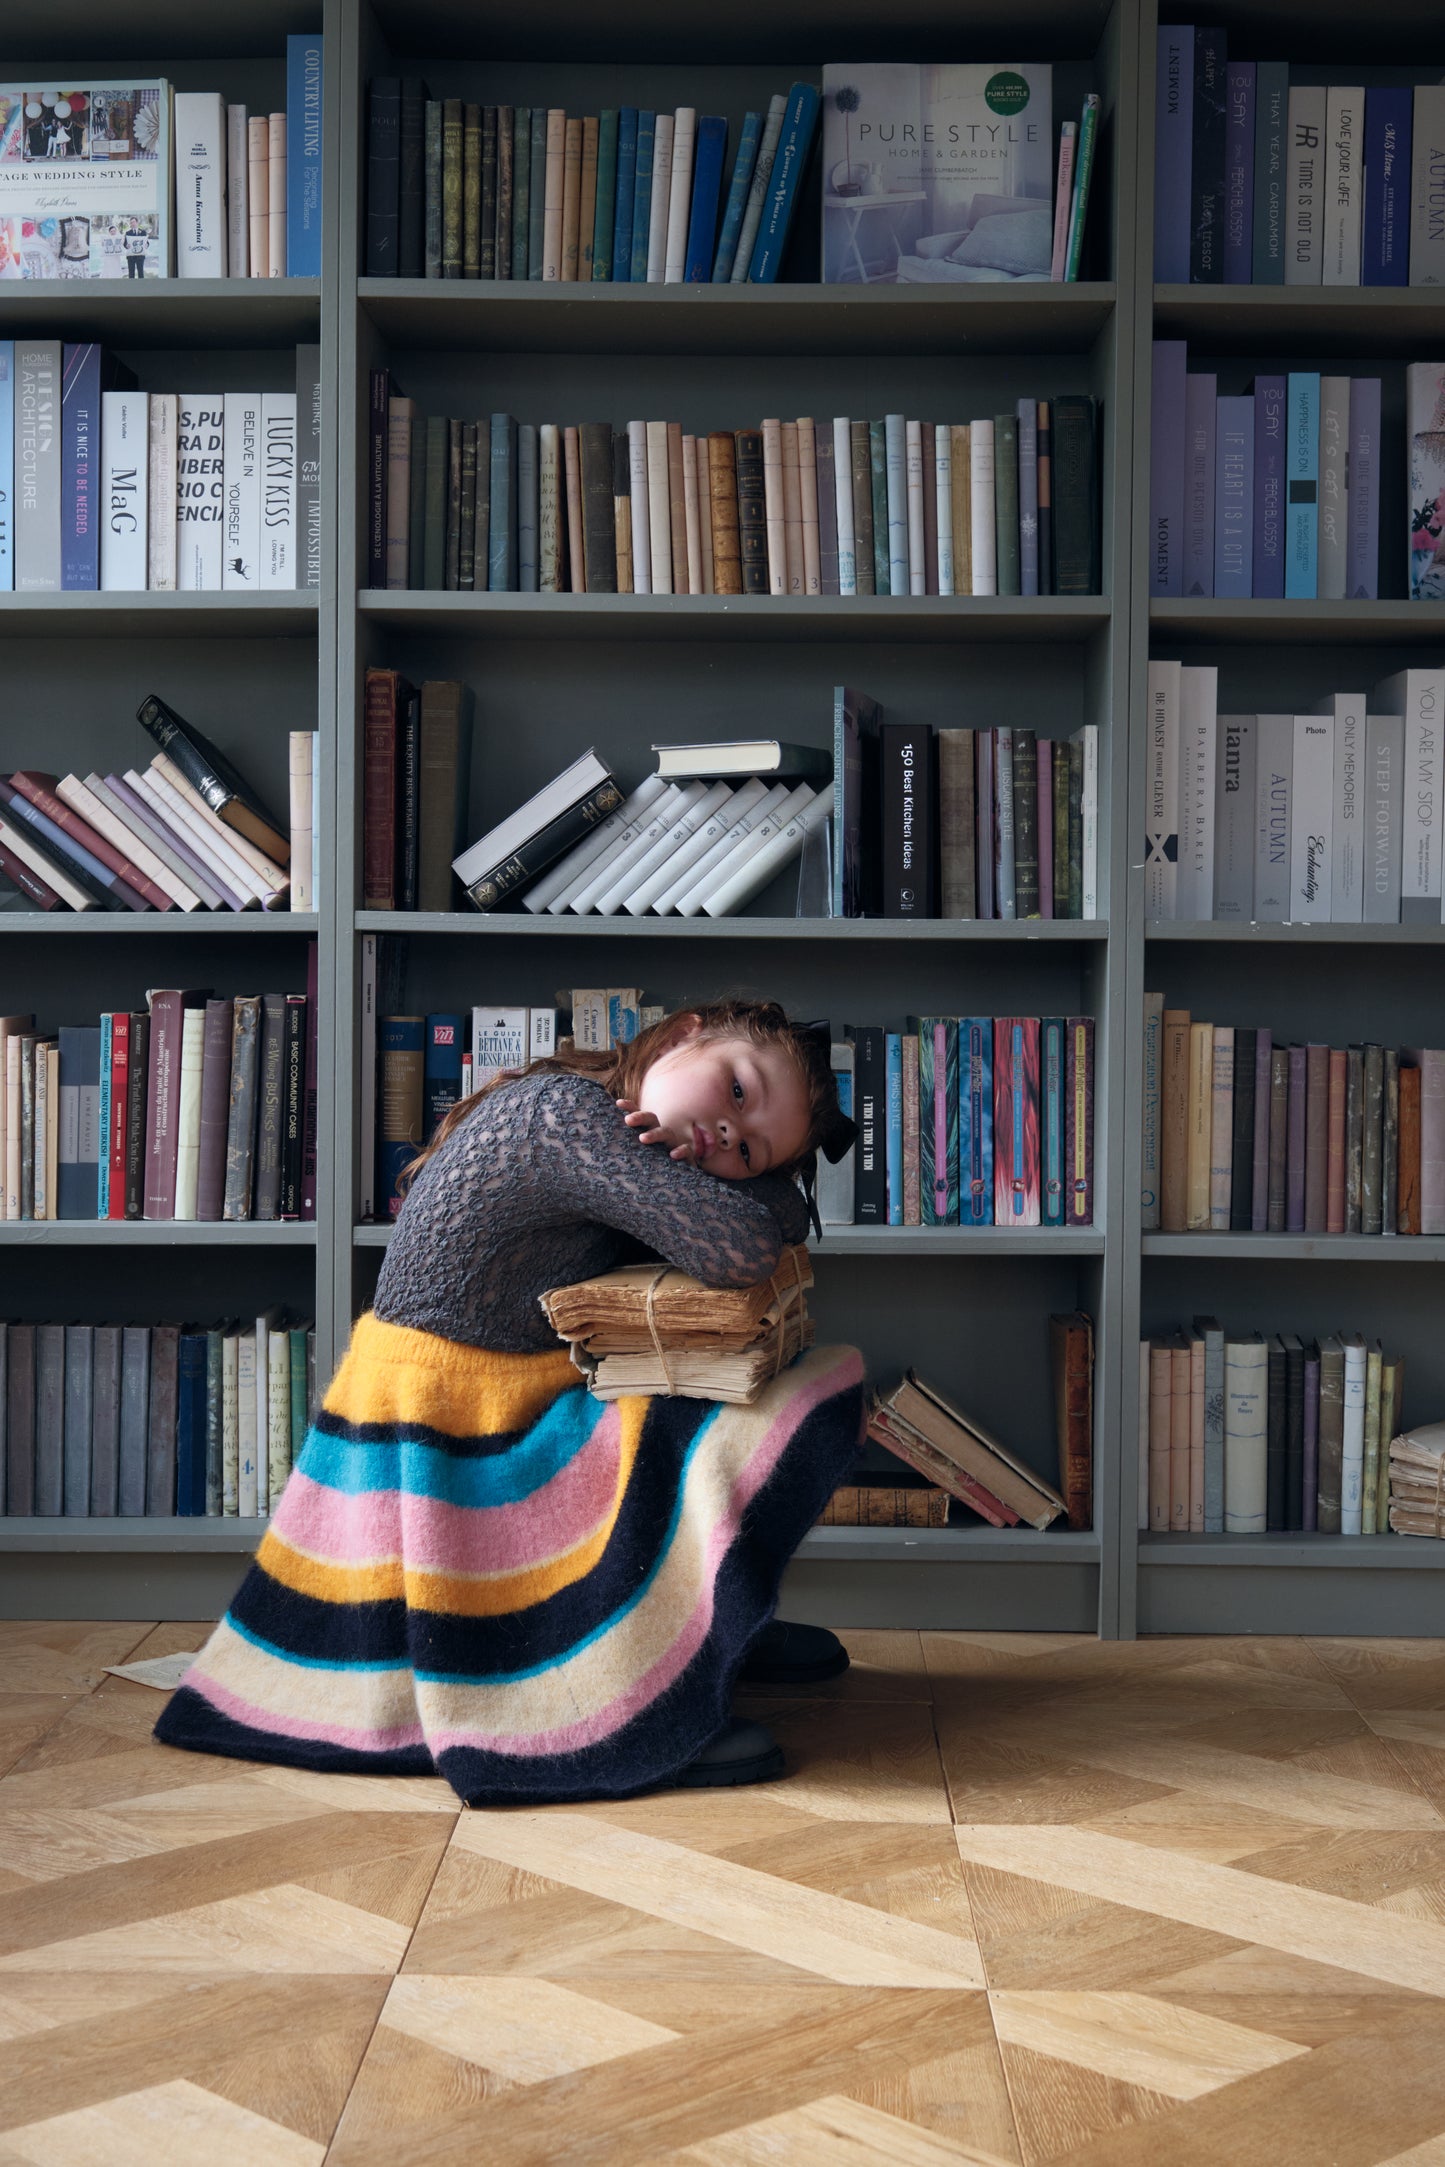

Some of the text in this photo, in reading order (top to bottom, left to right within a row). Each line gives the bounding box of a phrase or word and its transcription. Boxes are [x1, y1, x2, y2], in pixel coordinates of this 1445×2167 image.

[1168, 45, 1180, 115] MOMENT
[1204, 48, 1216, 89] HAPPY
[1231, 77, 1251, 87] YOU
[303, 49, 320, 157] COUNTRY LIVING
[1232, 92, 1247, 127] SAY
[1340, 109, 1352, 139] LOVE
[860, 124, 1038, 143] PURE STYLE
[889, 149, 1008, 158] HOME GARDEN
[33, 169, 143, 180] WEDDING STYLE
[303, 166, 311, 230] For The Seasons
[772, 145, 796, 217] GROWTH WORLD
[1269, 91, 1281, 258] THAT CARDAMOM
[1429, 148, 1445, 241] AUTUMN
[195, 174, 203, 242] Anna Karenina
[232, 177, 242, 234] Wine Tasting
[1296, 160, 1314, 263] TIME IS NOT OLD
[1201, 229, 1212, 270] tresor
[22, 353, 52, 363] HOME
[38, 372, 52, 452] DESIGN
[1263, 389, 1285, 400] YOU
[22, 371, 36, 509] ARCHITECTURE
[243, 410, 255, 477] BELIEVE IN
[1265, 404, 1279, 439] SAY
[1297, 392, 1309, 472] HAPPINESS IS ON
[75, 410, 88, 537] IT IS NICE TO BE NEEDED.
[264, 417, 294, 527] LUCKY KISS
[374, 434, 384, 559] DE L'ŒNOLOGIE LA VITICULTURE
[1323, 408, 1340, 546] LET'S GET LOST
[111, 467, 138, 535] MaG
[1222, 432, 1245, 574] IF HEART IS A CITY
[1356, 487, 1369, 526] PERSON
[307, 500, 320, 586] IMPOSSIBLE
[1157, 516, 1169, 585] MOMENT
[1263, 509, 1278, 556] BLOSSOM
[777, 576, 783, 589] 1
[792, 577, 800, 589] 2
[810, 576, 818, 589] 3
[404, 724, 414, 742] THE
[1154, 692, 1165, 778] BE HONEST RATHER
[1305, 726, 1326, 734] Photo
[1343, 715, 1355, 750] ONLY
[404, 743, 414, 775] EQUITY
[833, 703, 842, 819] FRENCH COUNTRY LIVING
[1225, 726, 1248, 793] ianra
[1417, 686, 1435, 827] YOU ARE MY STOP
[404, 777, 414, 795] RISK
[901, 743, 914, 870] 150 Best Kitchen Ideas
[1002, 767, 1012, 841] TUSCANY STYLE
[1194, 727, 1207, 872] BARBERA BAREY
[1342, 752, 1355, 819] MEMORIES
[404, 798, 414, 839] PREMIUM
[622, 832, 632, 841] 3
[706, 827, 716, 836] 6
[760, 827, 770, 836] 8
[786, 828, 796, 838] 9
[1270, 773, 1288, 864] AUTUMN
[1375, 746, 1391, 894] STEP FORWARD
[478, 1037, 521, 1052] BETTANE &
[591, 1009, 599, 1044] Cases and
[288, 1010, 299, 1139] RUDDEN BASIC COMMUNITY CASES
[478, 1052, 522, 1067] DESSEAUVE
[972, 1056, 982, 1074] Harry
[972, 1073, 982, 1094] Potter
[1075, 1072, 1086, 1093] Potter
[1076, 1055, 1086, 1072] Harry
[153, 1029, 165, 1155] Mise du de Maastricht
[161, 1048, 170, 1129] construction européenne
[891, 1072, 901, 1130] PARIS STYLE
[1144, 1015, 1160, 1172] Organization Development
[130, 1067, 142, 1175] The Truth Shall Make You Free
[863, 1102, 873, 1170] KILL KILL KILL
[304, 1156, 315, 1176] SOIF
[287, 1184, 295, 1211] OXFORD
[1155, 1506, 1161, 1517] 1
[1176, 1504, 1183, 1516] 2
[1195, 1503, 1203, 1515] 3
